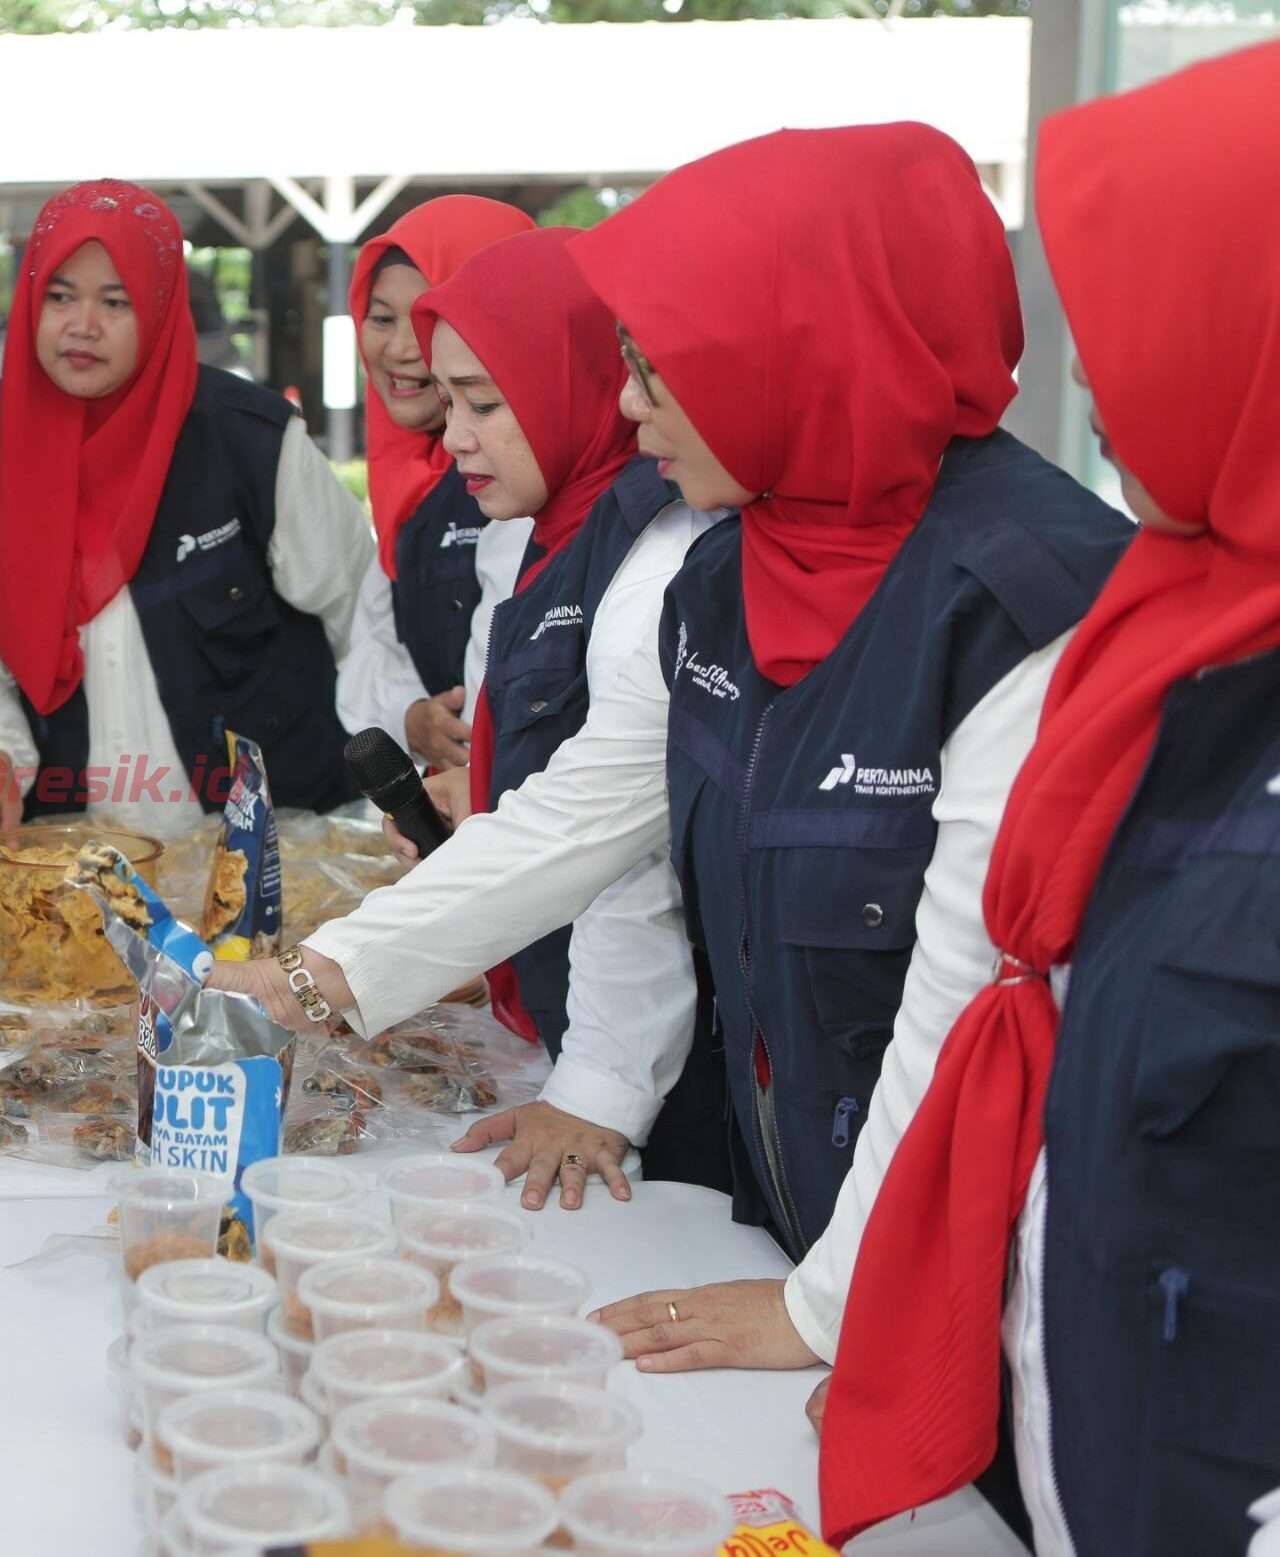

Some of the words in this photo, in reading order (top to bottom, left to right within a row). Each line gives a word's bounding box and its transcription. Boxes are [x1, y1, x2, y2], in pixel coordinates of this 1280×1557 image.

[856, 767, 934, 785] PERTAMINA
[155, 1068, 236, 1095] UPUK
[174, 1133, 228, 1147] BATAM
[167, 1146, 228, 1174] SKIN
